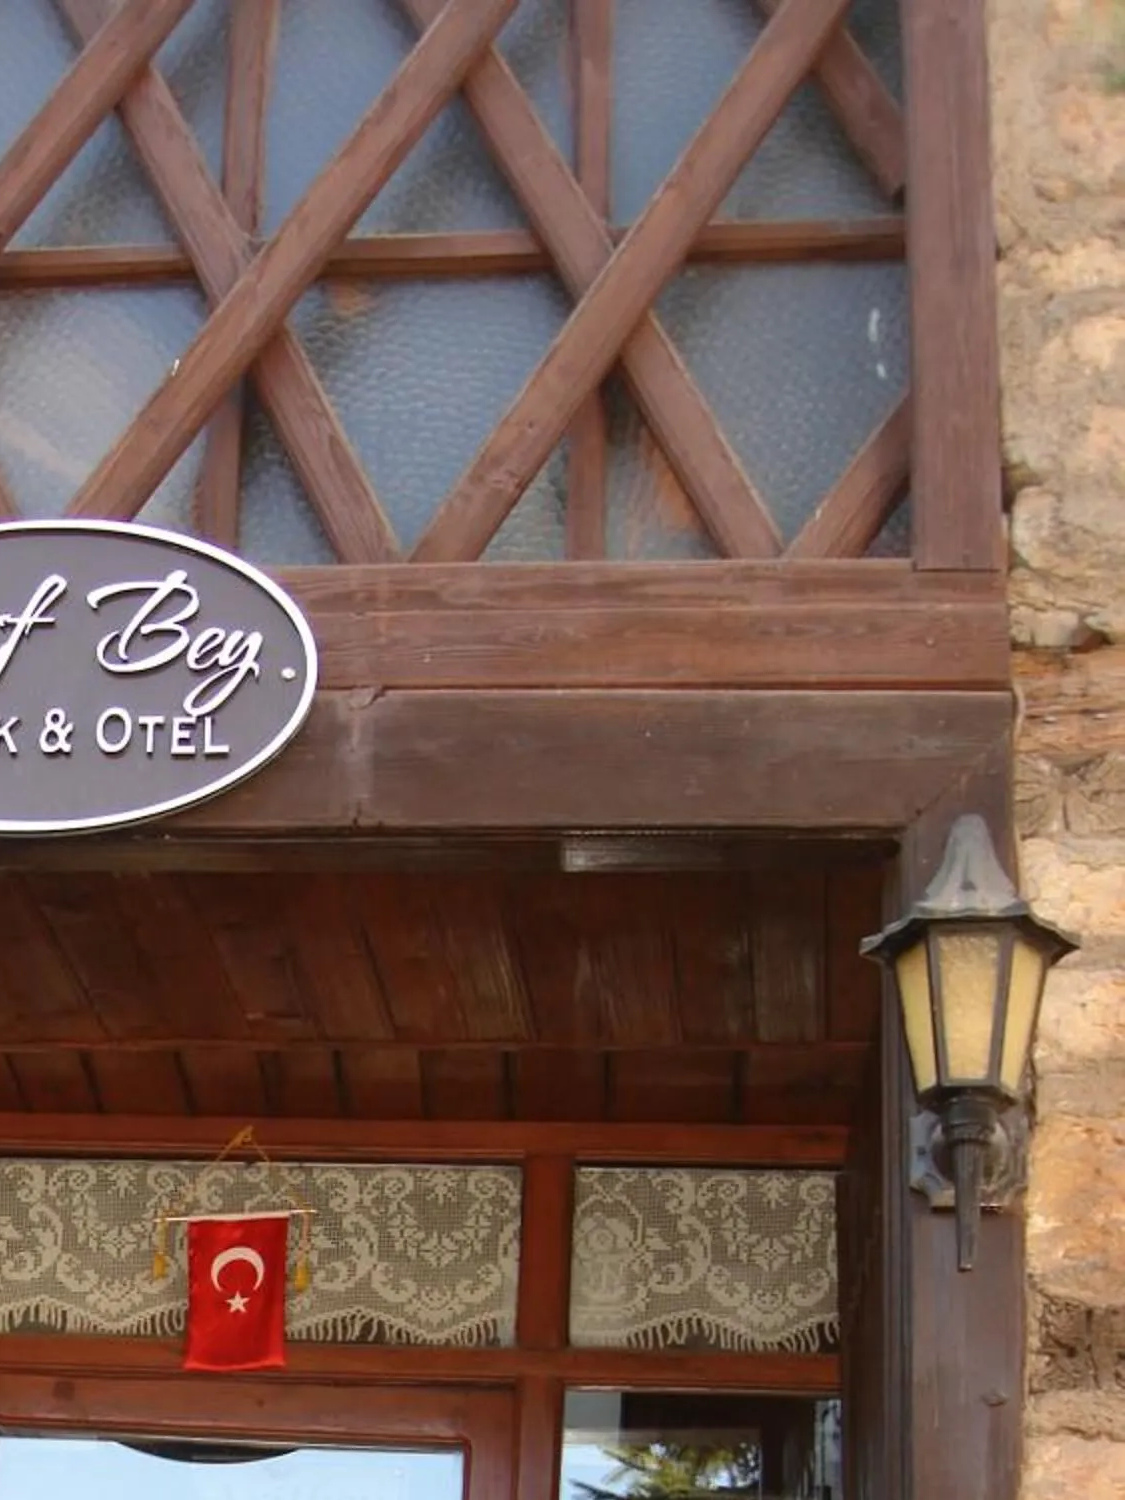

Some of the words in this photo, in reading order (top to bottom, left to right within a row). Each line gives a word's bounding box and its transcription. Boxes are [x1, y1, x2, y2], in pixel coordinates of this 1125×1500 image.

[86, 569, 262, 718] Bey
[39, 707, 73, 754] &
[95, 706, 230, 755] OTEL
